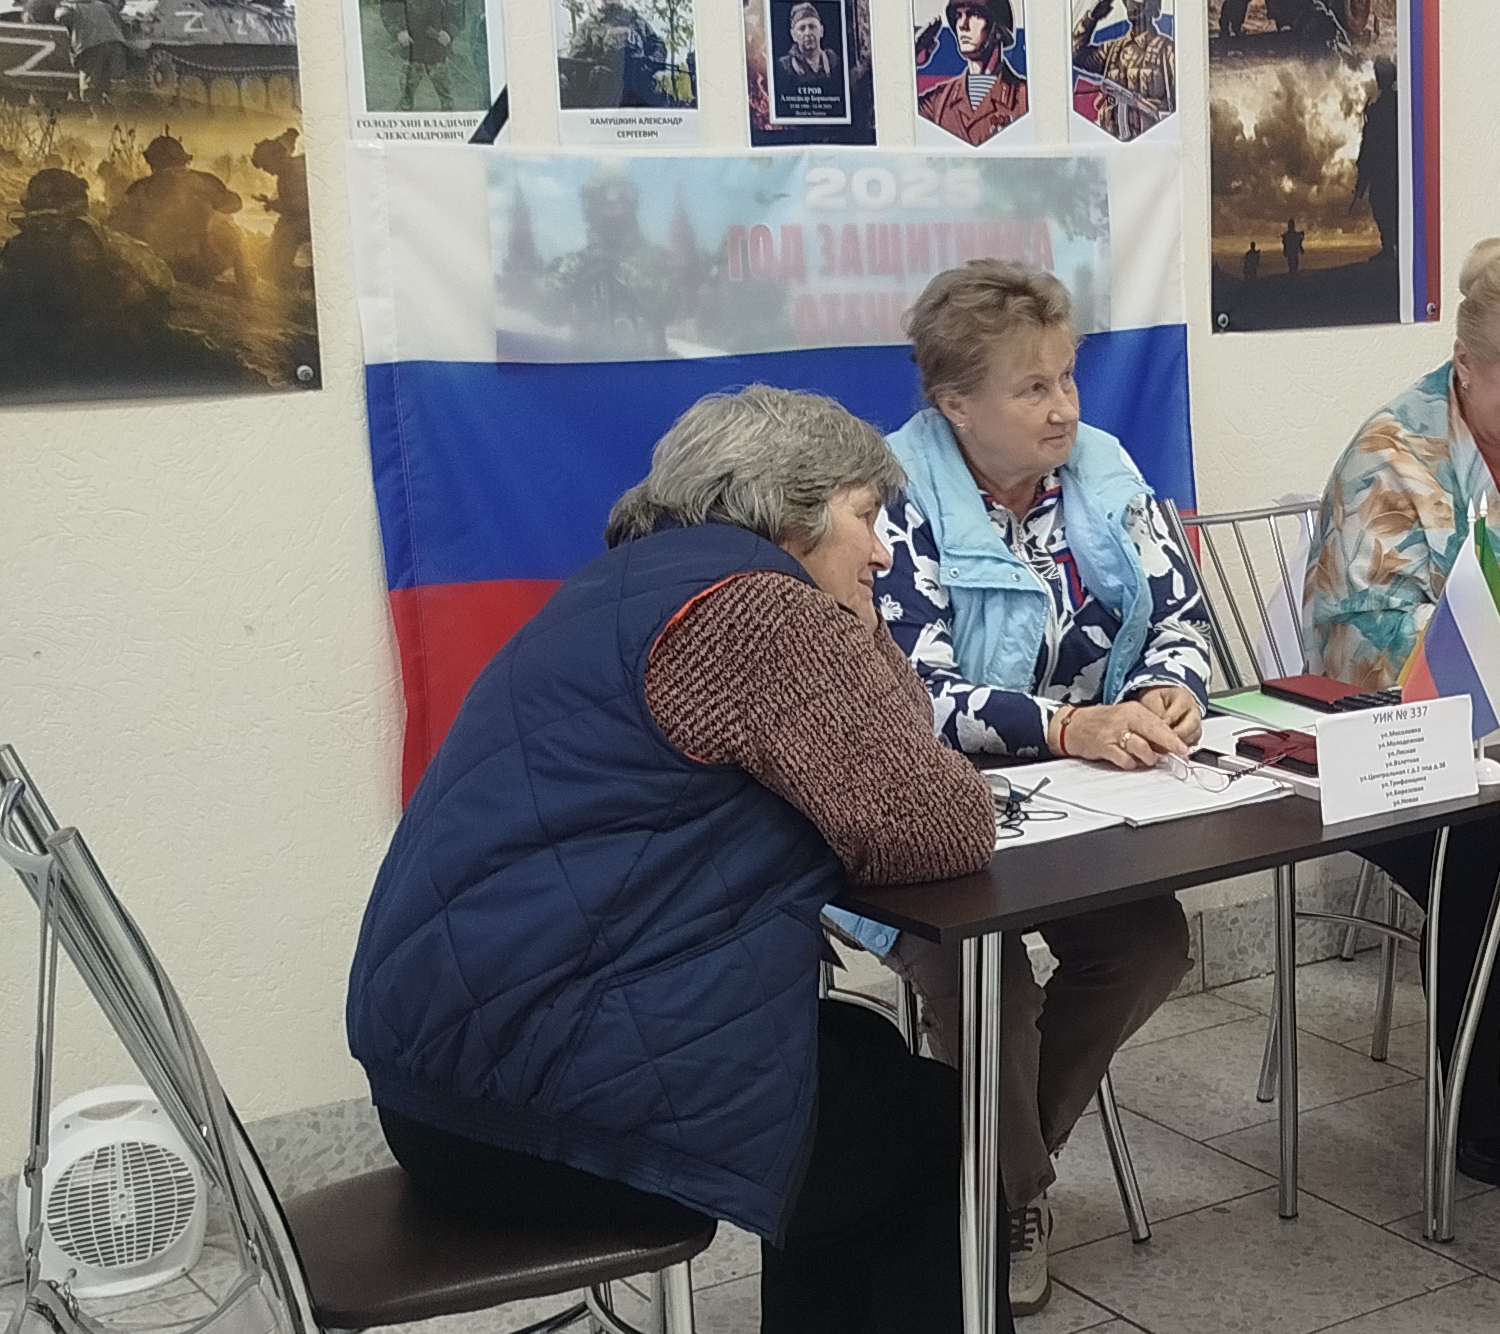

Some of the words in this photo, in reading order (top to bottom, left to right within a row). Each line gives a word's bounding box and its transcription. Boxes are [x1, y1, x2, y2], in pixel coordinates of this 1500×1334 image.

[423, 119, 479, 128] ВЛАДИМИР
[638, 116, 683, 126] АЛЕКСАНДР
[376, 131, 465, 140] АЛЕКСАНДРОВИЧ
[616, 130, 659, 139] СЕРГЕЕВИЧ
[804, 167, 981, 213] 2025
[727, 223, 806, 282] ГОД
[1372, 711, 1394, 725] УИК
[1395, 708, 1408, 720] №
[1410, 706, 1428, 719] 337
[1387, 748, 1417, 759] ул.Лесная
[1359, 769, 1406, 783] ул.Центральная
